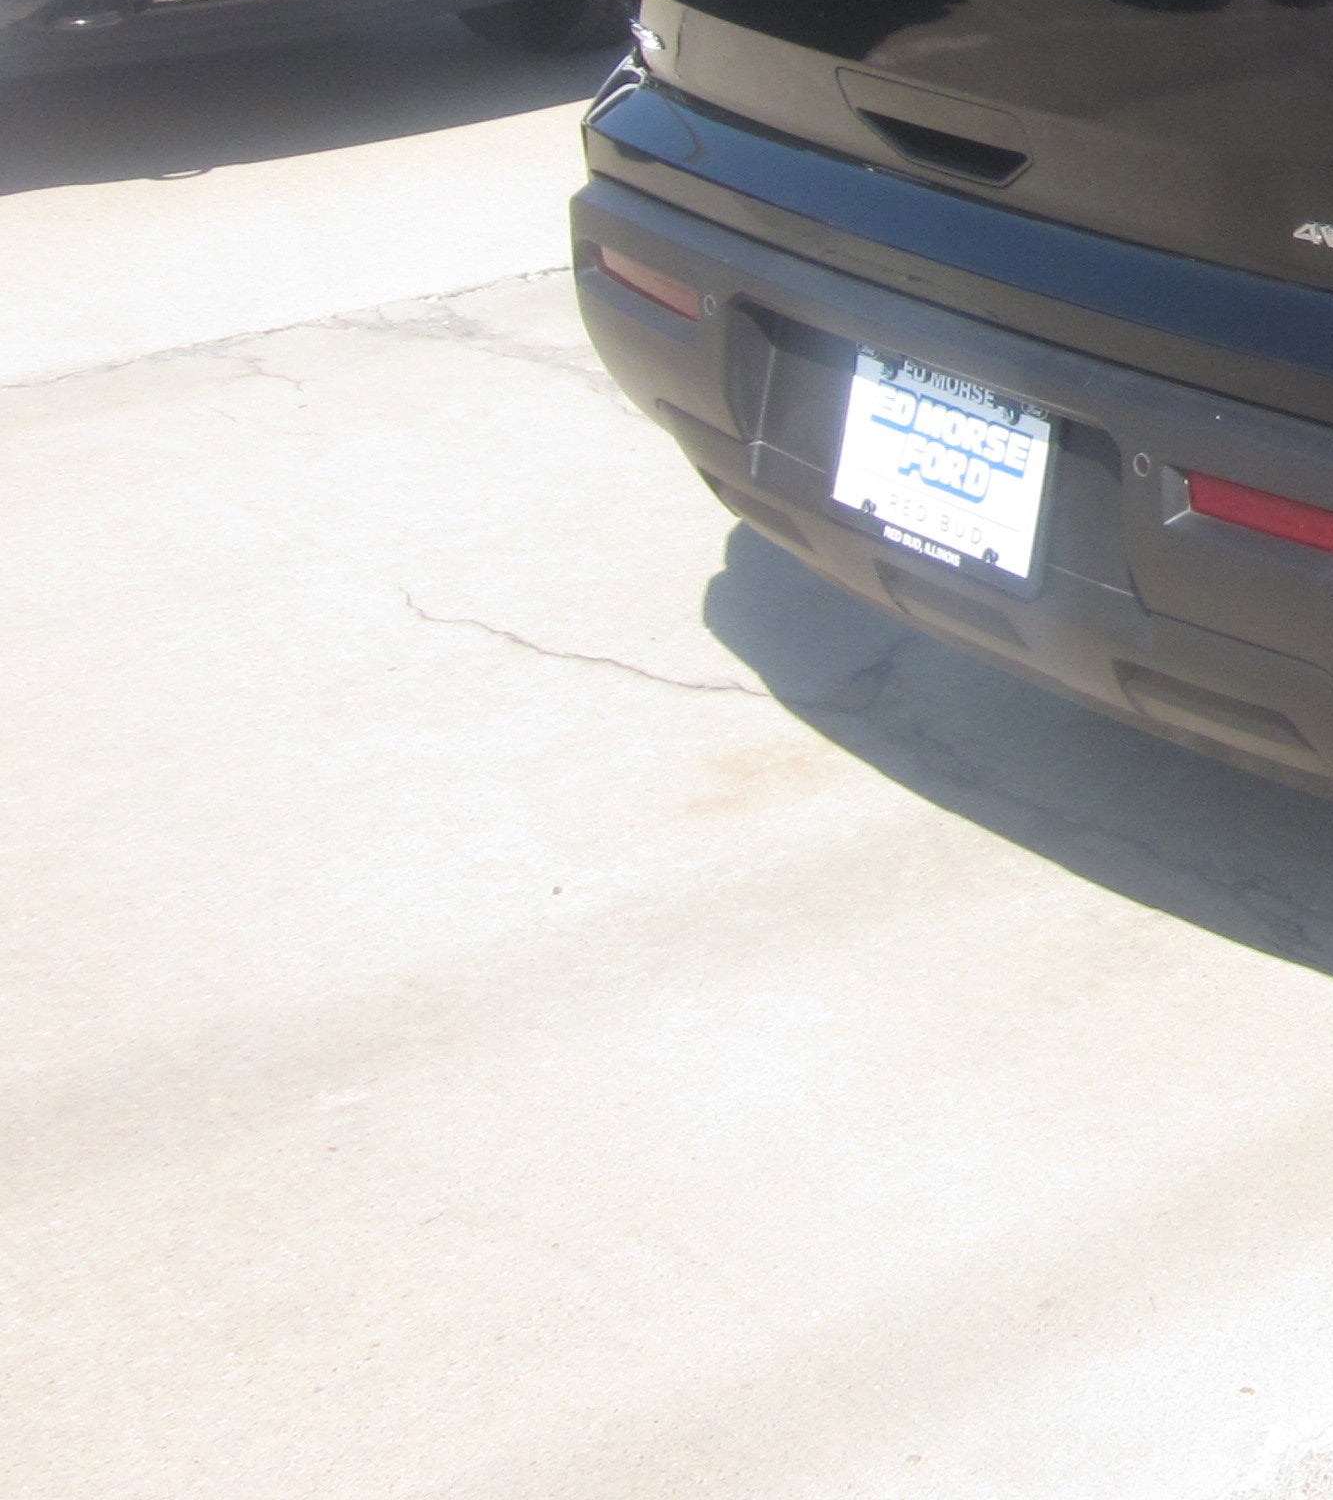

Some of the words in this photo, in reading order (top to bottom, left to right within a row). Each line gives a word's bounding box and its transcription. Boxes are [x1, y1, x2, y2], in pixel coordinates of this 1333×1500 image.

[903, 359, 927, 383] ED
[929, 370, 998, 410] MORSE
[872, 380, 918, 432] ED
[912, 396, 1034, 476] MORSE
[898, 432, 992, 504] FORD
[883, 525, 903, 544] RED
[921, 541, 962, 568] ILLINOIS
[939, 513, 984, 546] BUD
